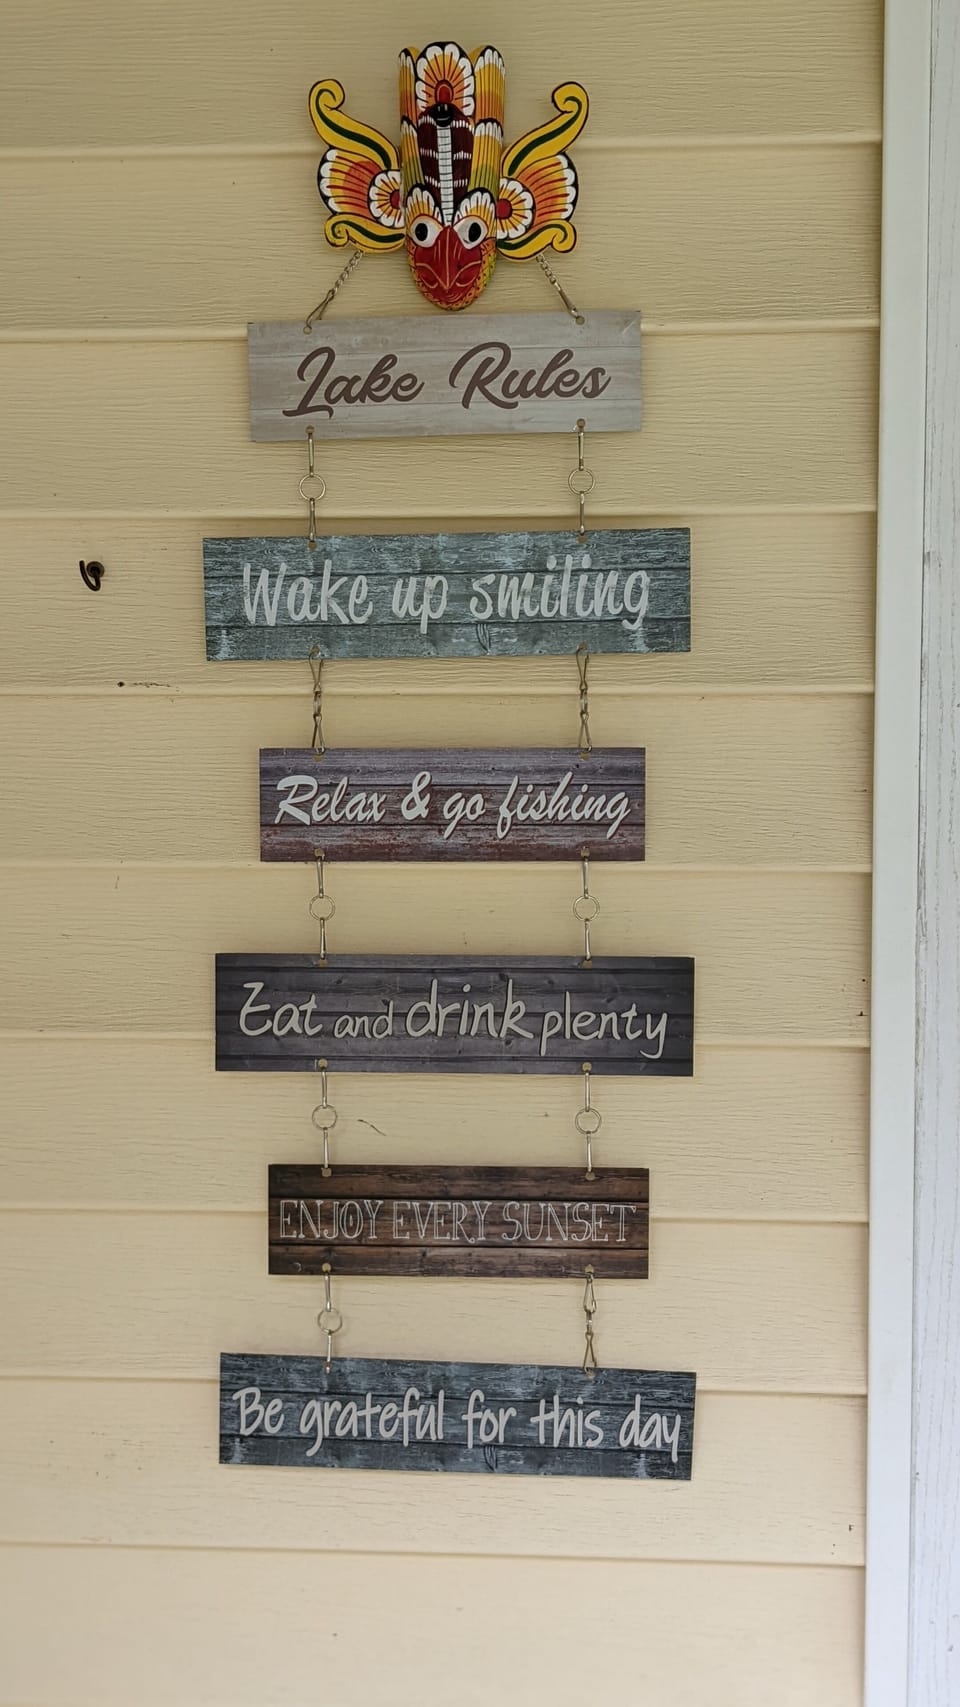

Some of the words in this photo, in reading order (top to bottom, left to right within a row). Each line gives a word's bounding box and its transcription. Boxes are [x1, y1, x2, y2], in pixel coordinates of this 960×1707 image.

[282, 346, 424, 419] Lake
[449, 341, 611, 410] Rules
[242, 560, 373, 627] Wake
[392, 572, 449, 634] up
[469, 554, 650, 630] smiling
[275, 774, 386, 825] Relax
[399, 771, 434, 820] &
[443, 796, 485, 839] go
[496, 771, 632, 840] fishing
[239, 981, 322, 1037] Eat
[333, 1000, 392, 1039] and
[405, 978, 534, 1040] drink
[539, 991, 668, 1059] plenty
[279, 1200, 383, 1240] ENJOY
[392, 1200, 492, 1244] EVERY
[502, 1201, 637, 1243] SUNSET
[232, 1387, 285, 1436] Be
[300, 1387, 444, 1456] grateful
[462, 1389, 516, 1448] for
[530, 1395, 604, 1447] this
[619, 1394, 682, 1463] day
